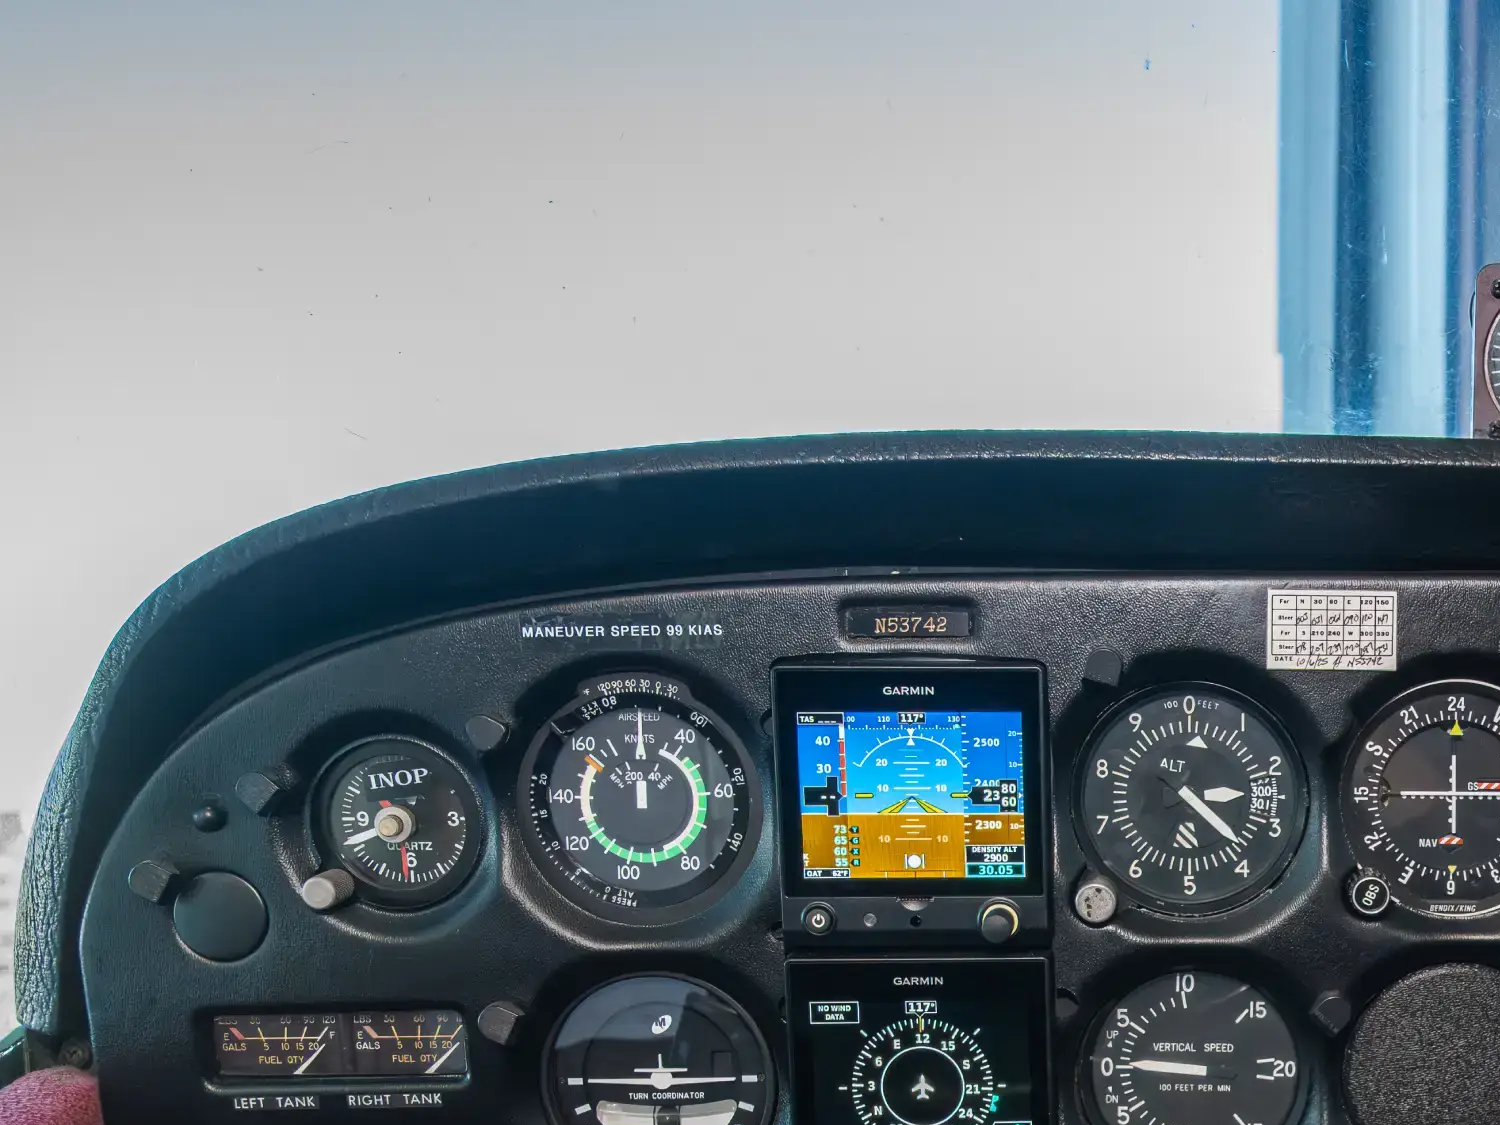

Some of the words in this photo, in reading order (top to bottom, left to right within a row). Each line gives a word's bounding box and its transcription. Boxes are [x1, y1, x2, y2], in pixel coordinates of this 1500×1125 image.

[874, 616, 947, 634] N53742
[522, 626, 605, 638] MANEUVER
[611, 626, 661, 637] SPEED
[666, 625, 683, 636] 99
[688, 625, 722, 636] KIAS
[883, 686, 934, 695] GARMIN
[1163, 701, 1178, 709] 100
[1447, 697, 1465, 711] 24
[900, 714, 924, 722] 117°
[674, 730, 695, 743] 40
[815, 736, 830, 746] 40
[572, 737, 595, 751] 160
[974, 738, 1000, 747] 2500
[1160, 758, 1185, 772] ALT
[368, 768, 428, 789] INOP
[714, 785, 733, 798] 60
[975, 820, 1002, 830] 2300
[565, 837, 589, 850] 120
[1419, 839, 1438, 848] NAV
[984, 854, 1008, 862] 2900
[617, 866, 640, 880] 100
[978, 866, 1013, 876] 30.05
[1363, 884, 1380, 906] OBS
[1430, 904, 1476, 912] BENDIX/KING
[893, 977, 943, 986] GARMIN
[908, 1003, 936, 1012] 117°
[1153, 1042, 1196, 1052] VERTICAL
[1204, 1043, 1234, 1053] SPEED
[1273, 1060, 1295, 1077] 20
[1198, 1084, 1213, 1092] PER
[1217, 1084, 1231, 1092] MIN
[348, 1095, 391, 1107] RIGHT
[403, 1093, 442, 1104] TANK
[629, 1092, 649, 1100] TURN
[652, 1092, 705, 1100] COORDINATOR
[234, 1098, 265, 1109] LEFT
[277, 1096, 315, 1108] TANK
